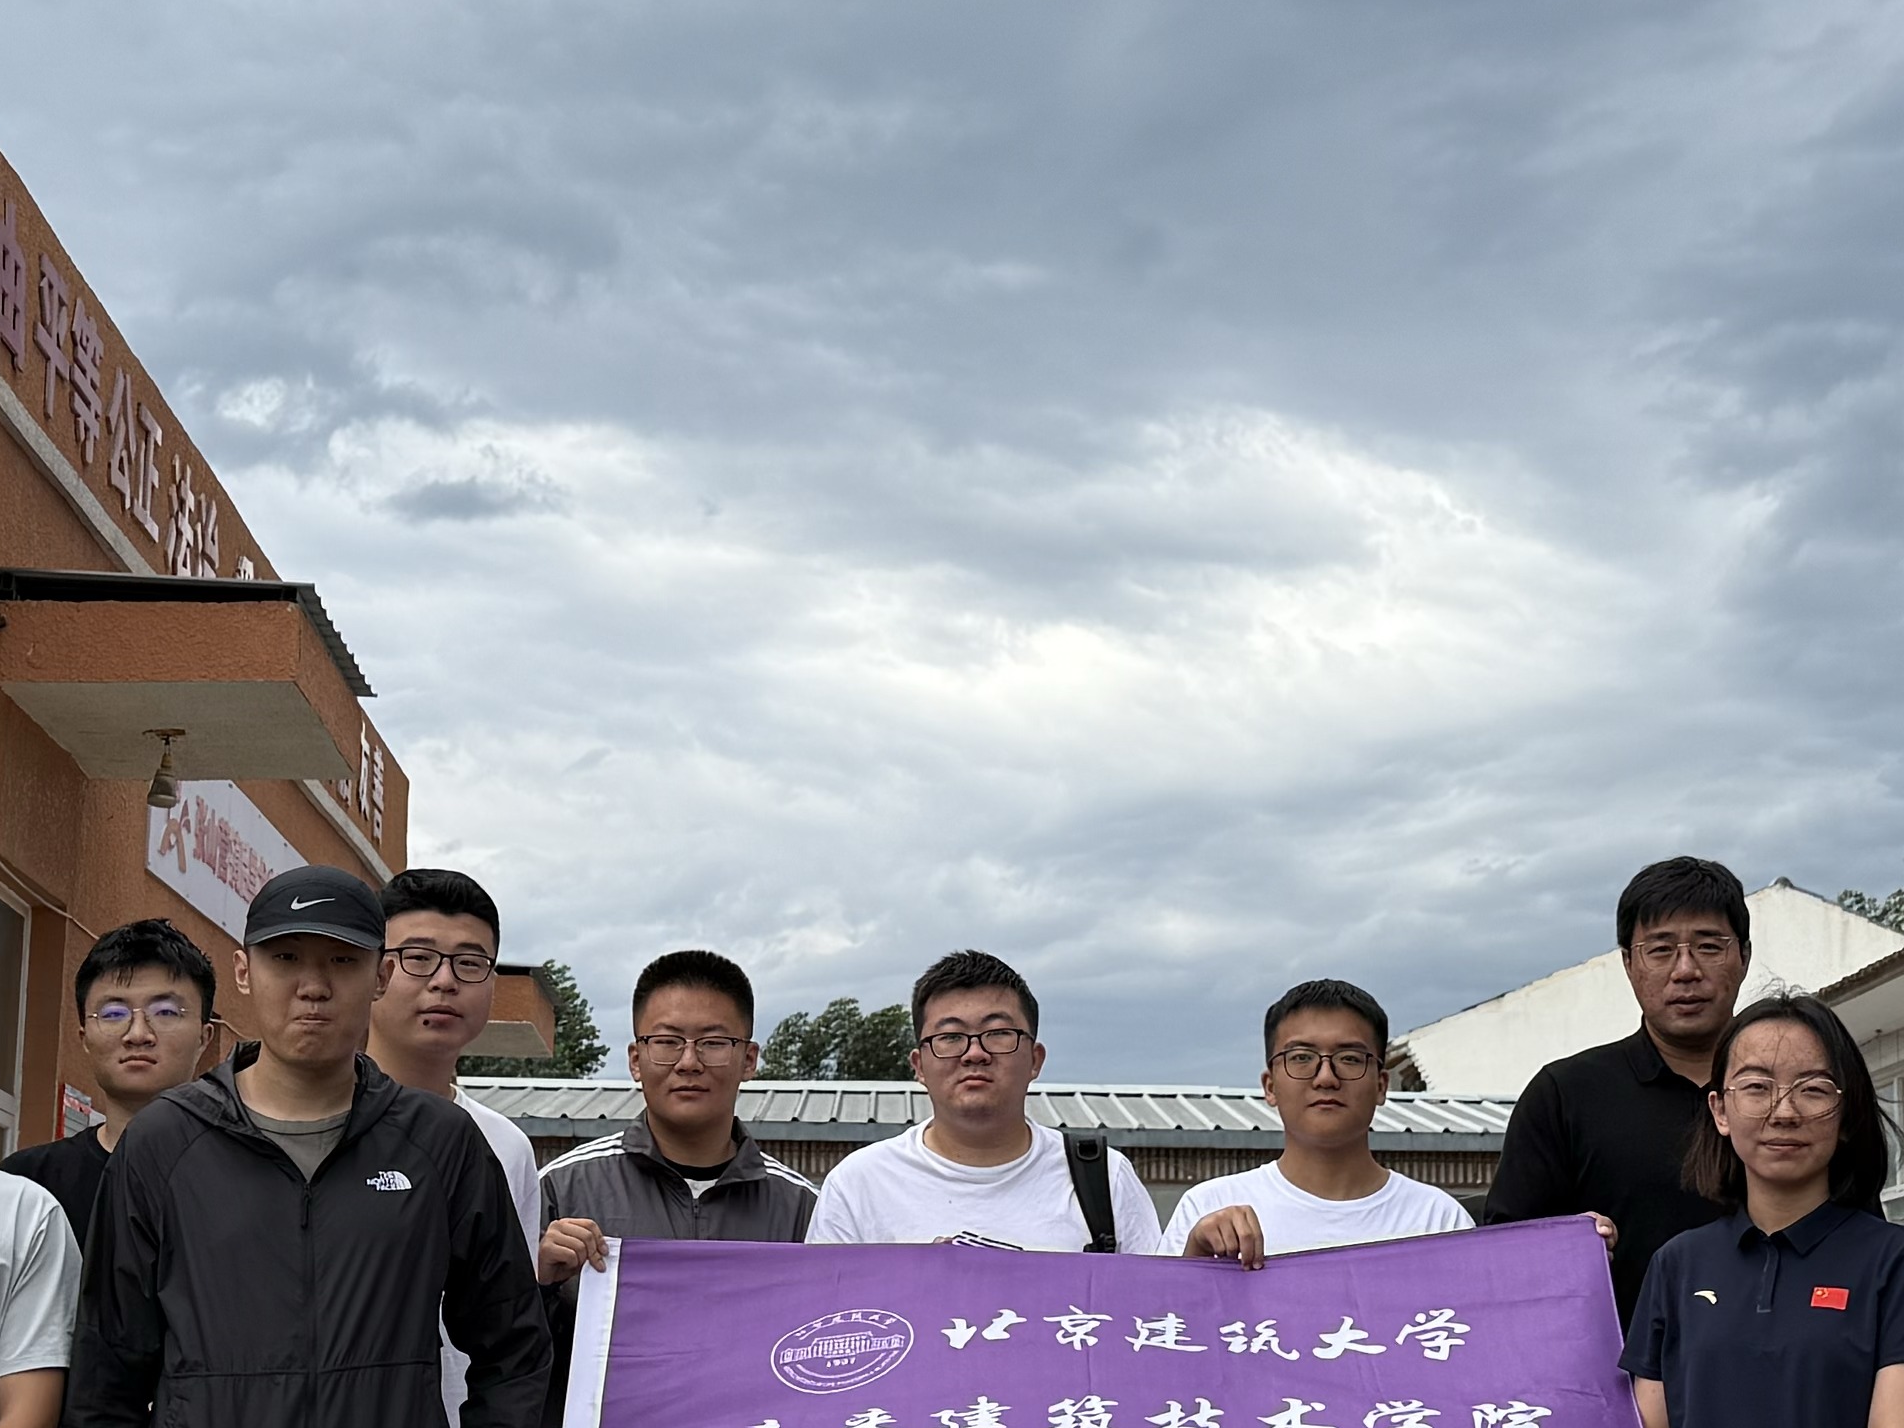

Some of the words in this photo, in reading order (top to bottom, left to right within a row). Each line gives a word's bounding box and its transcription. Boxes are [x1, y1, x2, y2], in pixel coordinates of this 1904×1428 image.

[34, 254, 103, 466] 平等
[107, 368, 163, 545] 公正
[942, 1305, 1471, 1361] 北京建筑大学
